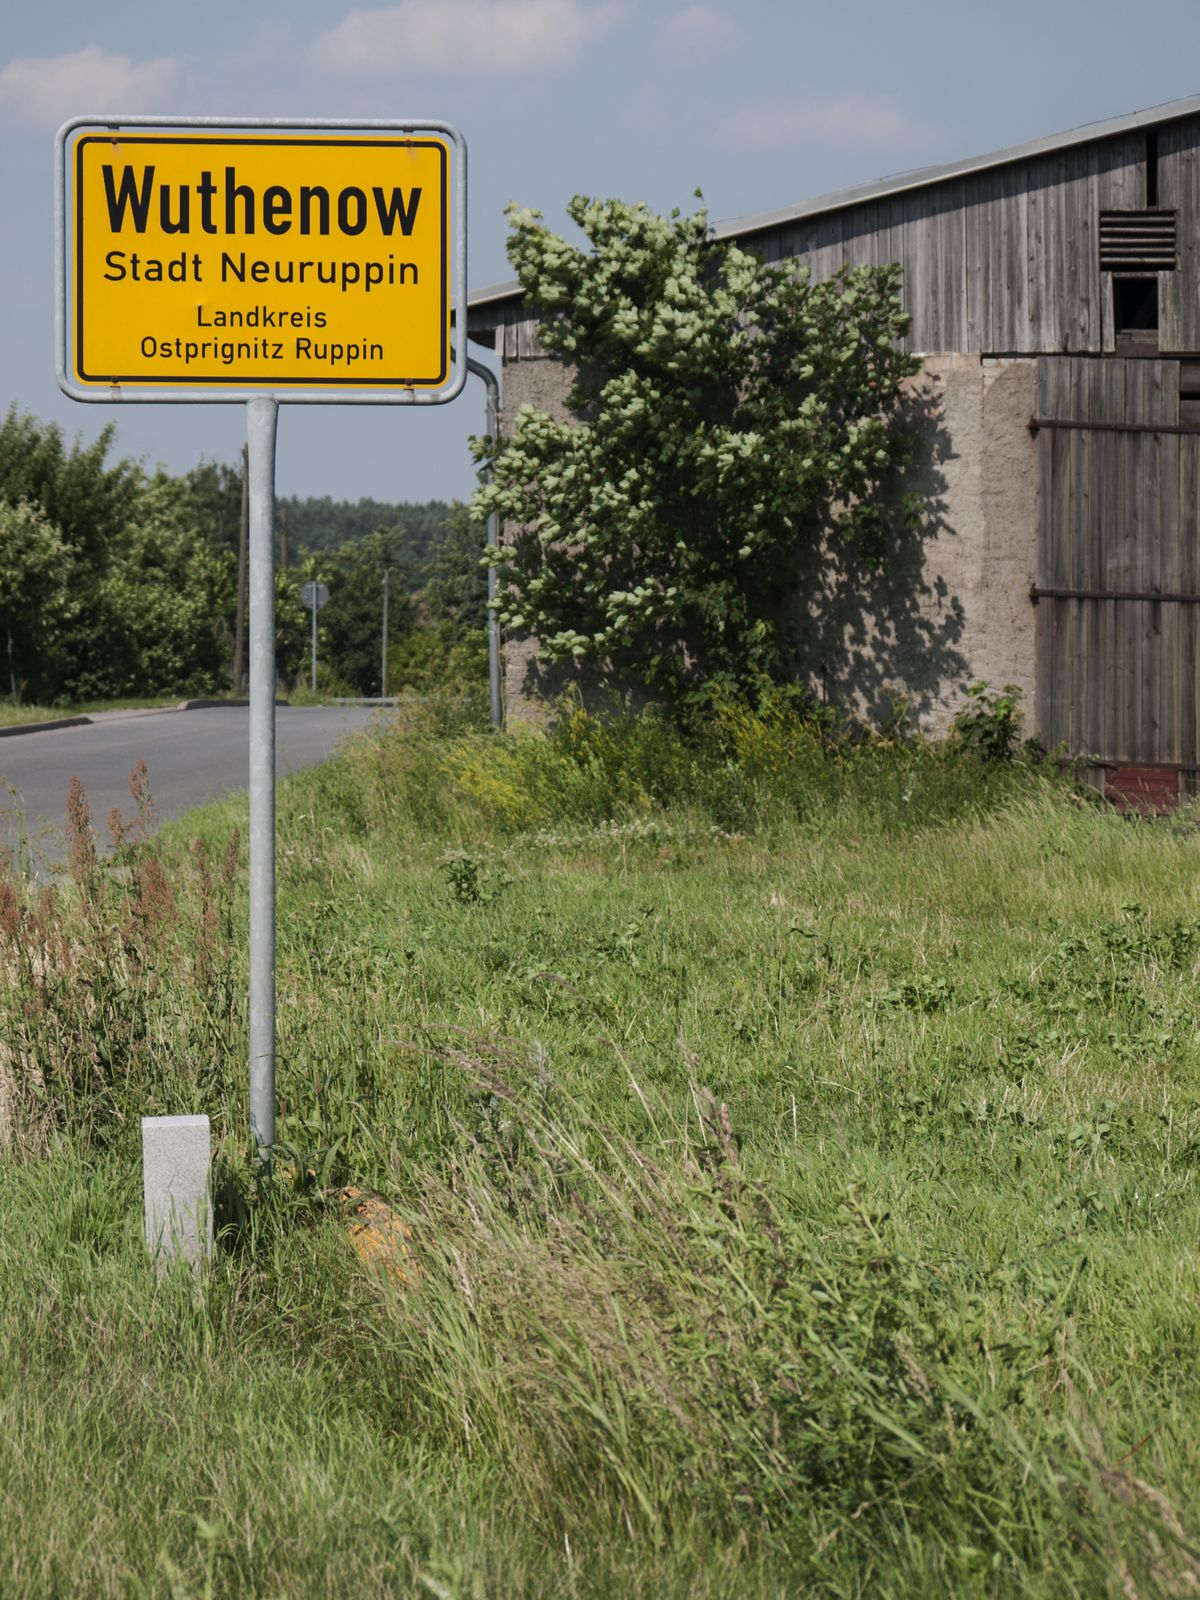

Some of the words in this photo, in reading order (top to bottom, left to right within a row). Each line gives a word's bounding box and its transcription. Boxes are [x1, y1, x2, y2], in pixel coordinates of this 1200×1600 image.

[101, 164, 422, 236] Wuthenow
[103, 250, 203, 283] Stadt
[221, 252, 419, 292] Neuruppin
[197, 305, 327, 328] Landkreis
[140, 336, 284, 365] Ostprignitz
[295, 337, 384, 366] Ruppin
